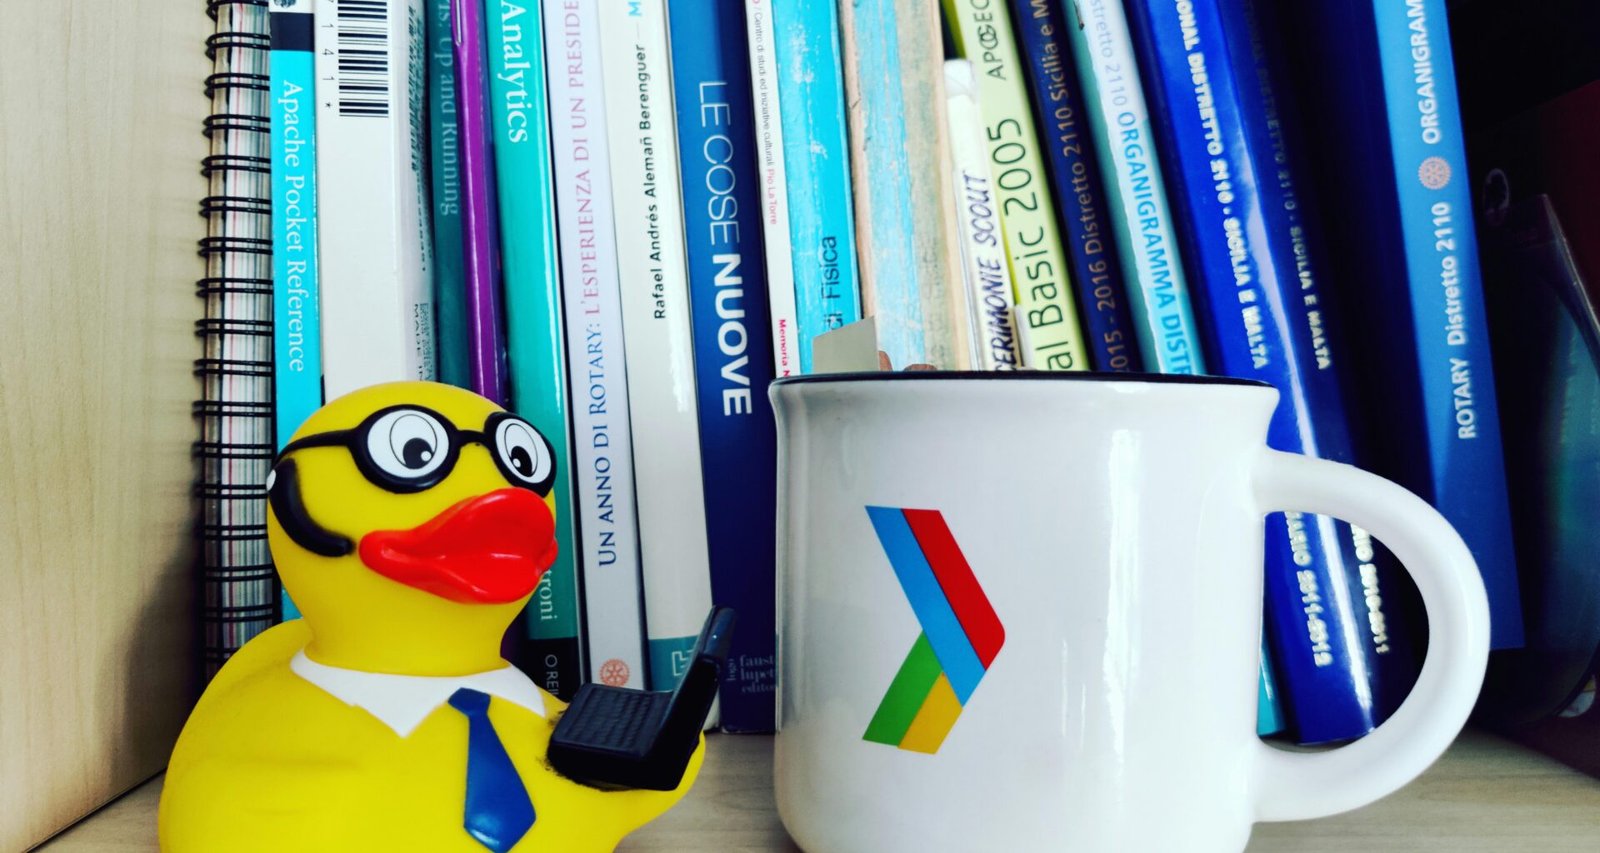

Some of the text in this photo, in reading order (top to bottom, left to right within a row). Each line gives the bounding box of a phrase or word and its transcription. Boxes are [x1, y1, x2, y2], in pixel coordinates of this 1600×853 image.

[434, 37, 453, 66] Up
[753, 12, 768, 45] Centro
[1040, 25, 1054, 35] e
[440, 74, 456, 113] and
[497, 3, 533, 144] Analytics
[758, 55, 769, 79] studi
[760, 78, 770, 90] ed
[1042, 41, 1069, 104] Sicilia
[760, 92, 773, 131] iniziative
[1055, 108, 1081, 156] 2110
[1187, 52, 1223, 156] DISTRETTO
[440, 121, 459, 216] Running
[763, 132, 775, 166] culturali
[766, 168, 776, 185] Pio
[987, 118, 1038, 216] 2005
[637, 43, 666, 319] Rafael Andrés Alemañ Berenguer
[768, 187, 777, 199] La
[769, 200, 779, 225] Torre
[962, 170, 998, 247] SCOUT
[1071, 164, 1106, 256] Distretto
[1104, 64, 1128, 106] 2110
[1116, 111, 1175, 309] ORGANIGRAMMA
[1210, 158, 1234, 204] 2110
[278, 80, 309, 372] Apache Pocket Reference
[699, 81, 753, 417] LE COSE NUOVE
[1222, 217, 1252, 287] SICILIA
[1431, 202, 1456, 252] 2110
[564, 1, 617, 567] UN ANNO DI ROTARY: L'ESPERIENZA DI UN PRESIDE
[820, 236, 841, 299] Fisica
[1014, 226, 1064, 329] Basic
[1088, 261, 1115, 311] 2016
[1290, 226, 1315, 290] SICILIA
[1238, 288, 1256, 304] E
[1304, 295, 1317, 306] E
[1436, 257, 1467, 347] Distretto
[777, 319, 789, 366] Memoria
[1242, 306, 1269, 369] MALTA
[1307, 310, 1332, 369] MALTA
[1446, 358, 1477, 440] ROTARY
[1296, 570, 1333, 667] 2011-2012
